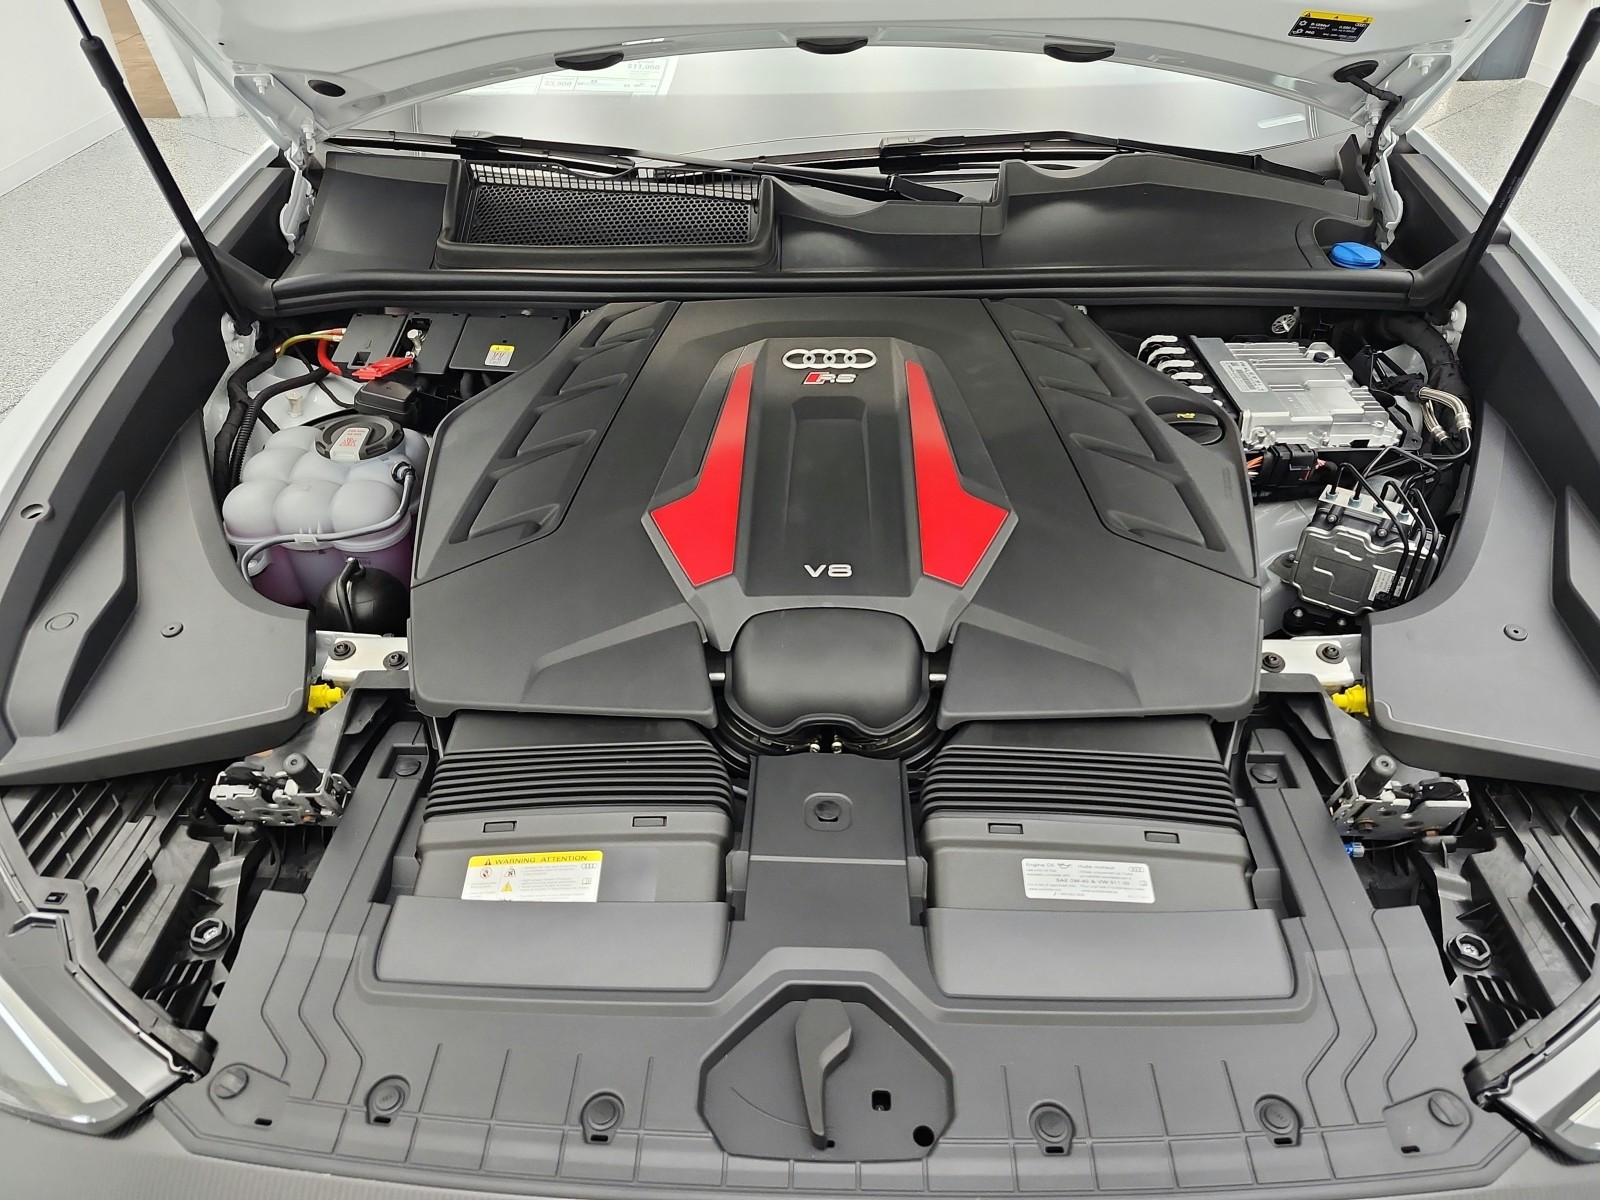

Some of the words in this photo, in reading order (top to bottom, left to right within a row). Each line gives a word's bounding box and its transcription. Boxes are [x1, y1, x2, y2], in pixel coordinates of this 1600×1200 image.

[803, 564, 853, 578] V8
[495, 856, 536, 865] WARNING
[540, 854, 588, 863] ATTENTION
